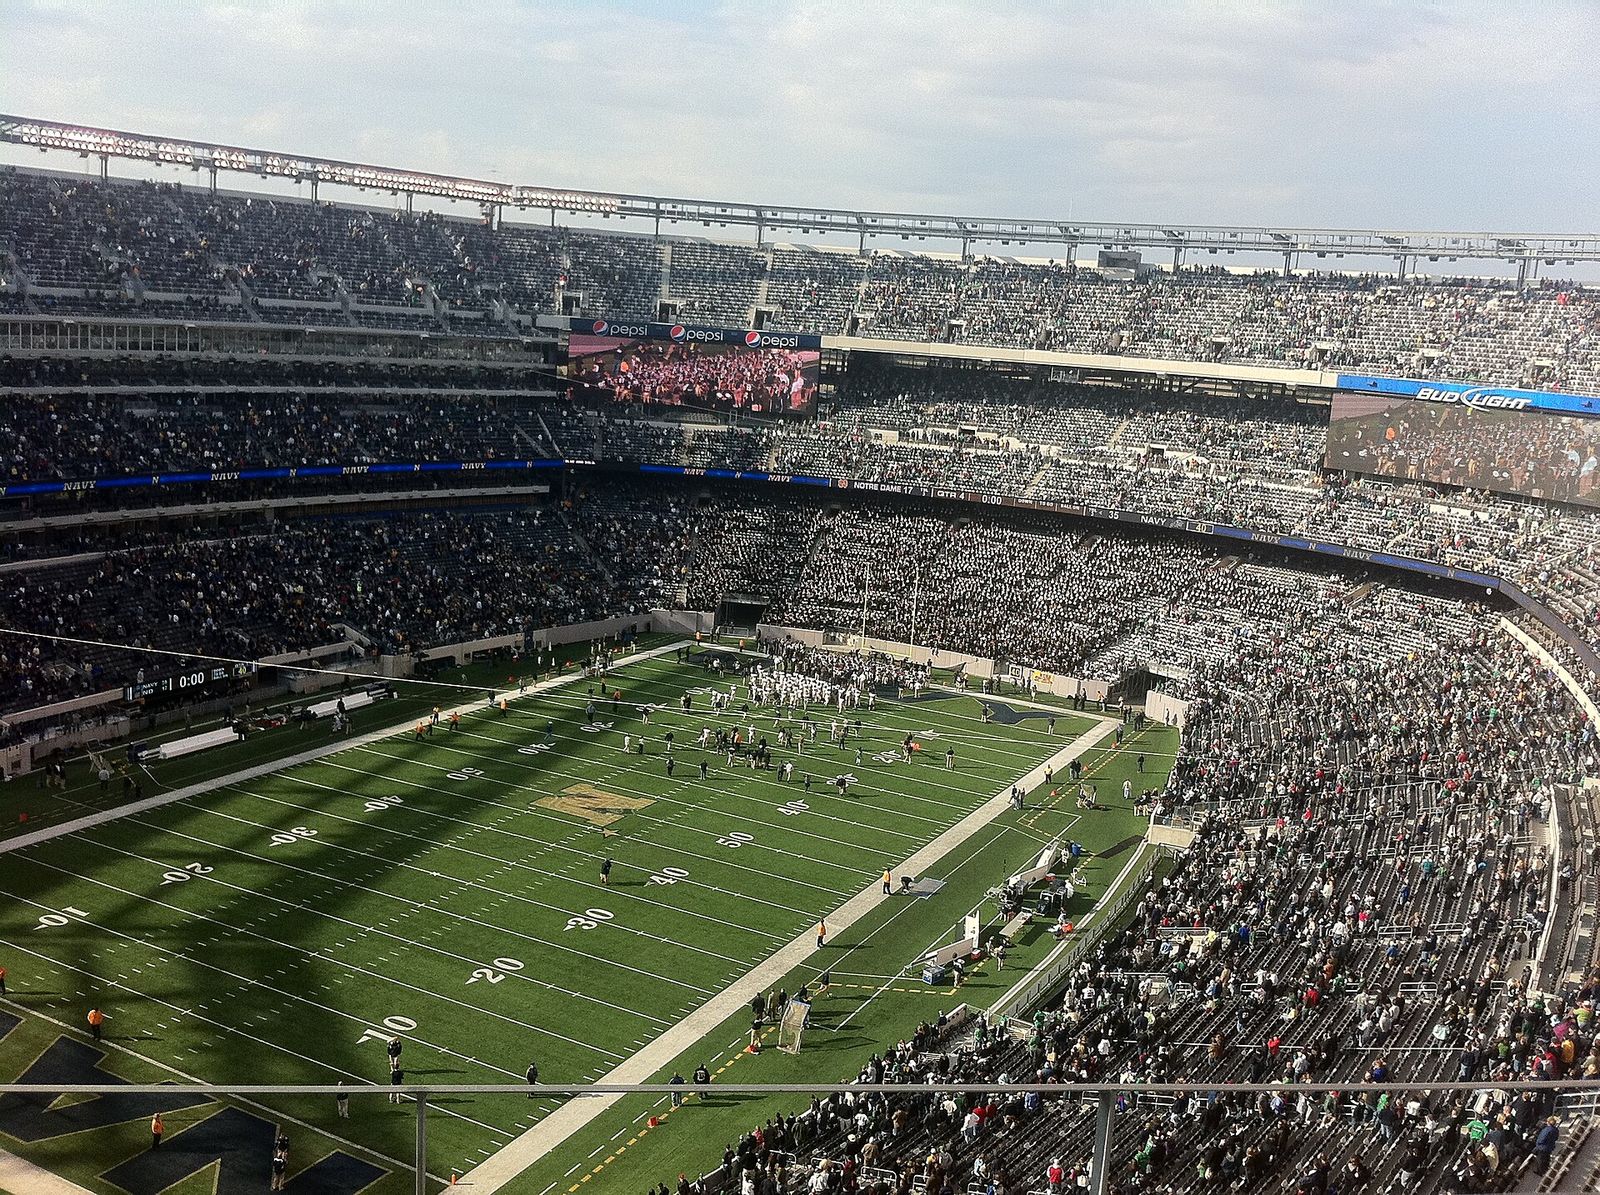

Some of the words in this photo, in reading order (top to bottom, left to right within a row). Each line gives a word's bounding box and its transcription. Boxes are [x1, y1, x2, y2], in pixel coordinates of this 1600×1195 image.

[610, 324, 648, 338] pepsi
[685, 329, 724, 344] pepsi
[761, 334, 799, 349] pepsi
[1415, 387, 1461, 403] BUD
[1471, 392, 1533, 410] LIGHT
[289, 467, 297, 477] N
[342, 465, 370, 475] NAVY
[413, 463, 421, 471] N
[461, 462, 486, 470] NAVY
[152, 476, 160, 485] N
[210, 471, 241, 481] NAVY
[767, 474, 793, 483] NAVY
[63, 480, 97, 491] NAVY
[853, 481, 879, 491] NOTRE
[879, 483, 902, 493] DAME
[903, 486, 913, 494] 17
[937, 490, 957, 498] QTR
[959, 491, 965, 500] 4
[981, 494, 1002, 505] 0:00
[1108, 511, 1120, 520] 35
[1140, 515, 1166, 526] NAVY
[1251, 533, 1281, 544] NAVY
[1343, 549, 1373, 561] NAVY
[179, 671, 205, 688] 0:00
[446, 767, 485, 781] 50
[368, 795, 403, 812] 40
[777, 800, 810, 817] 40
[270, 826, 318, 845] 30
[716, 831, 754, 848] 50
[162, 862, 214, 883] 20
[648, 866, 690, 888] 40
[38, 905, 90, 927] 10
[566, 907, 614, 931] 30
[472, 957, 525, 985] 20
[364, 1015, 418, 1043] 10
